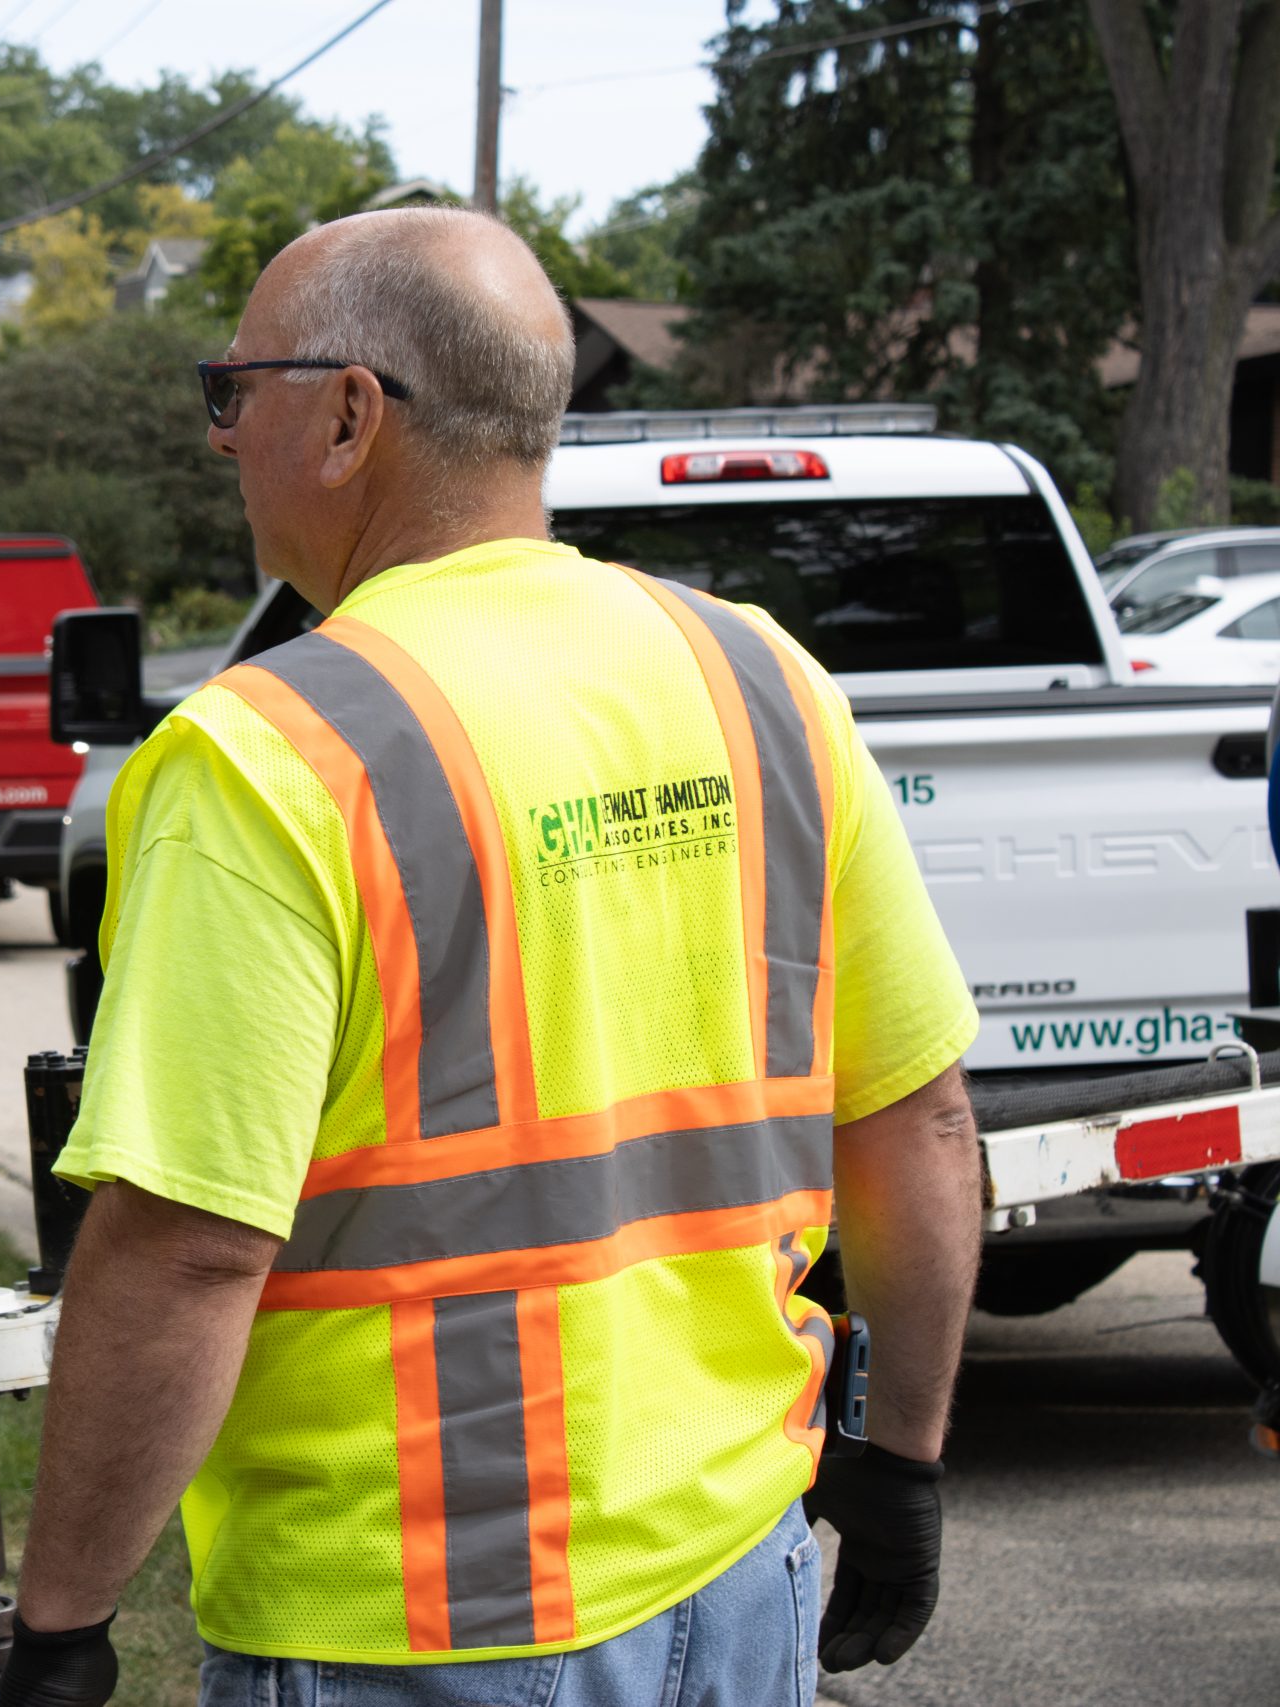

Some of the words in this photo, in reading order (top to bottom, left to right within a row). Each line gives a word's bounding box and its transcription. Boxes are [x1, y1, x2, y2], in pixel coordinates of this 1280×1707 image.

[600, 787, 648, 824] EWALT
[654, 774, 732, 816] HAMILTON
[893, 774, 936, 806] 15
[528, 796, 600, 863] GHA
[703, 811, 736, 831] INC.
